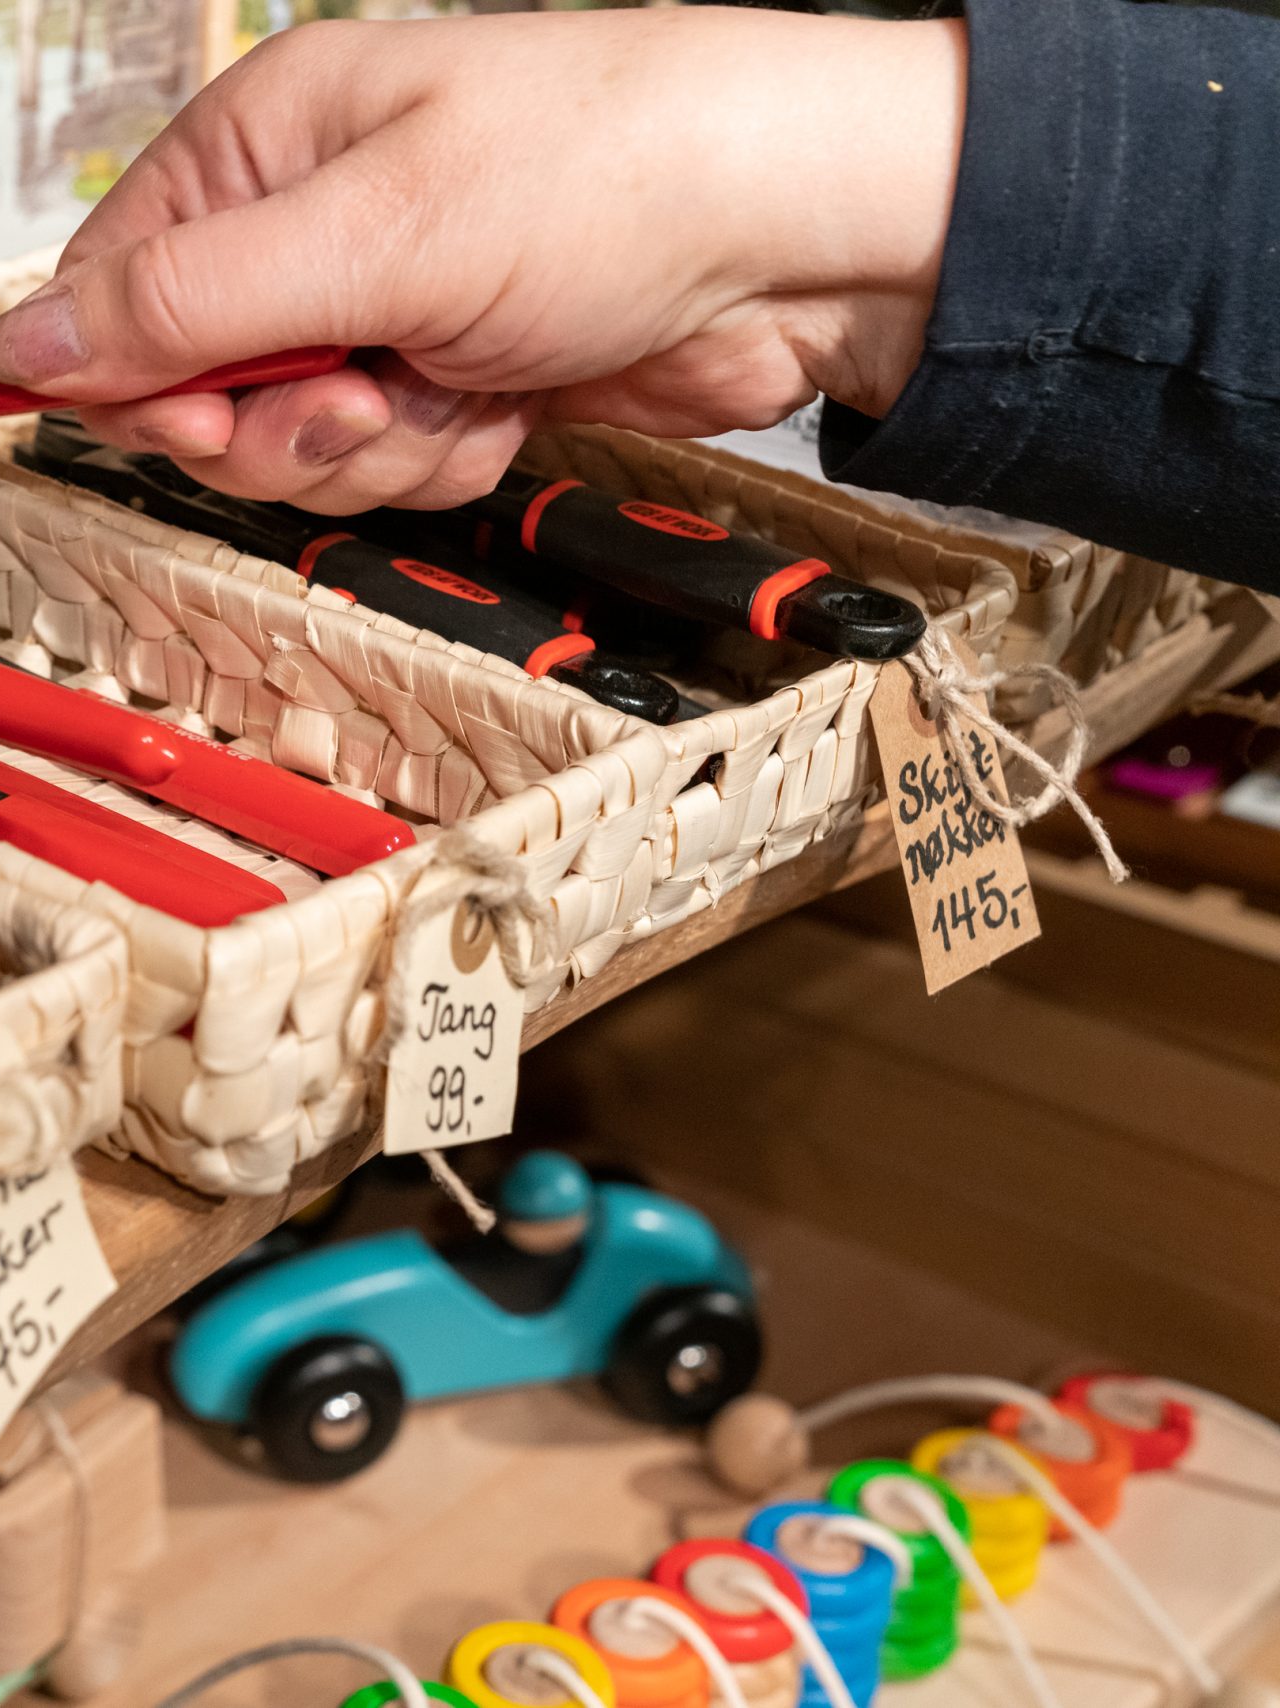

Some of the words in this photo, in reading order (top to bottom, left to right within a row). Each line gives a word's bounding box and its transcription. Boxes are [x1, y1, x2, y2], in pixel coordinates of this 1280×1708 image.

[931, 870, 1028, 952] 145,-
[417, 982, 497, 1061] Tang
[426, 1066, 485, 1136] 99,-
